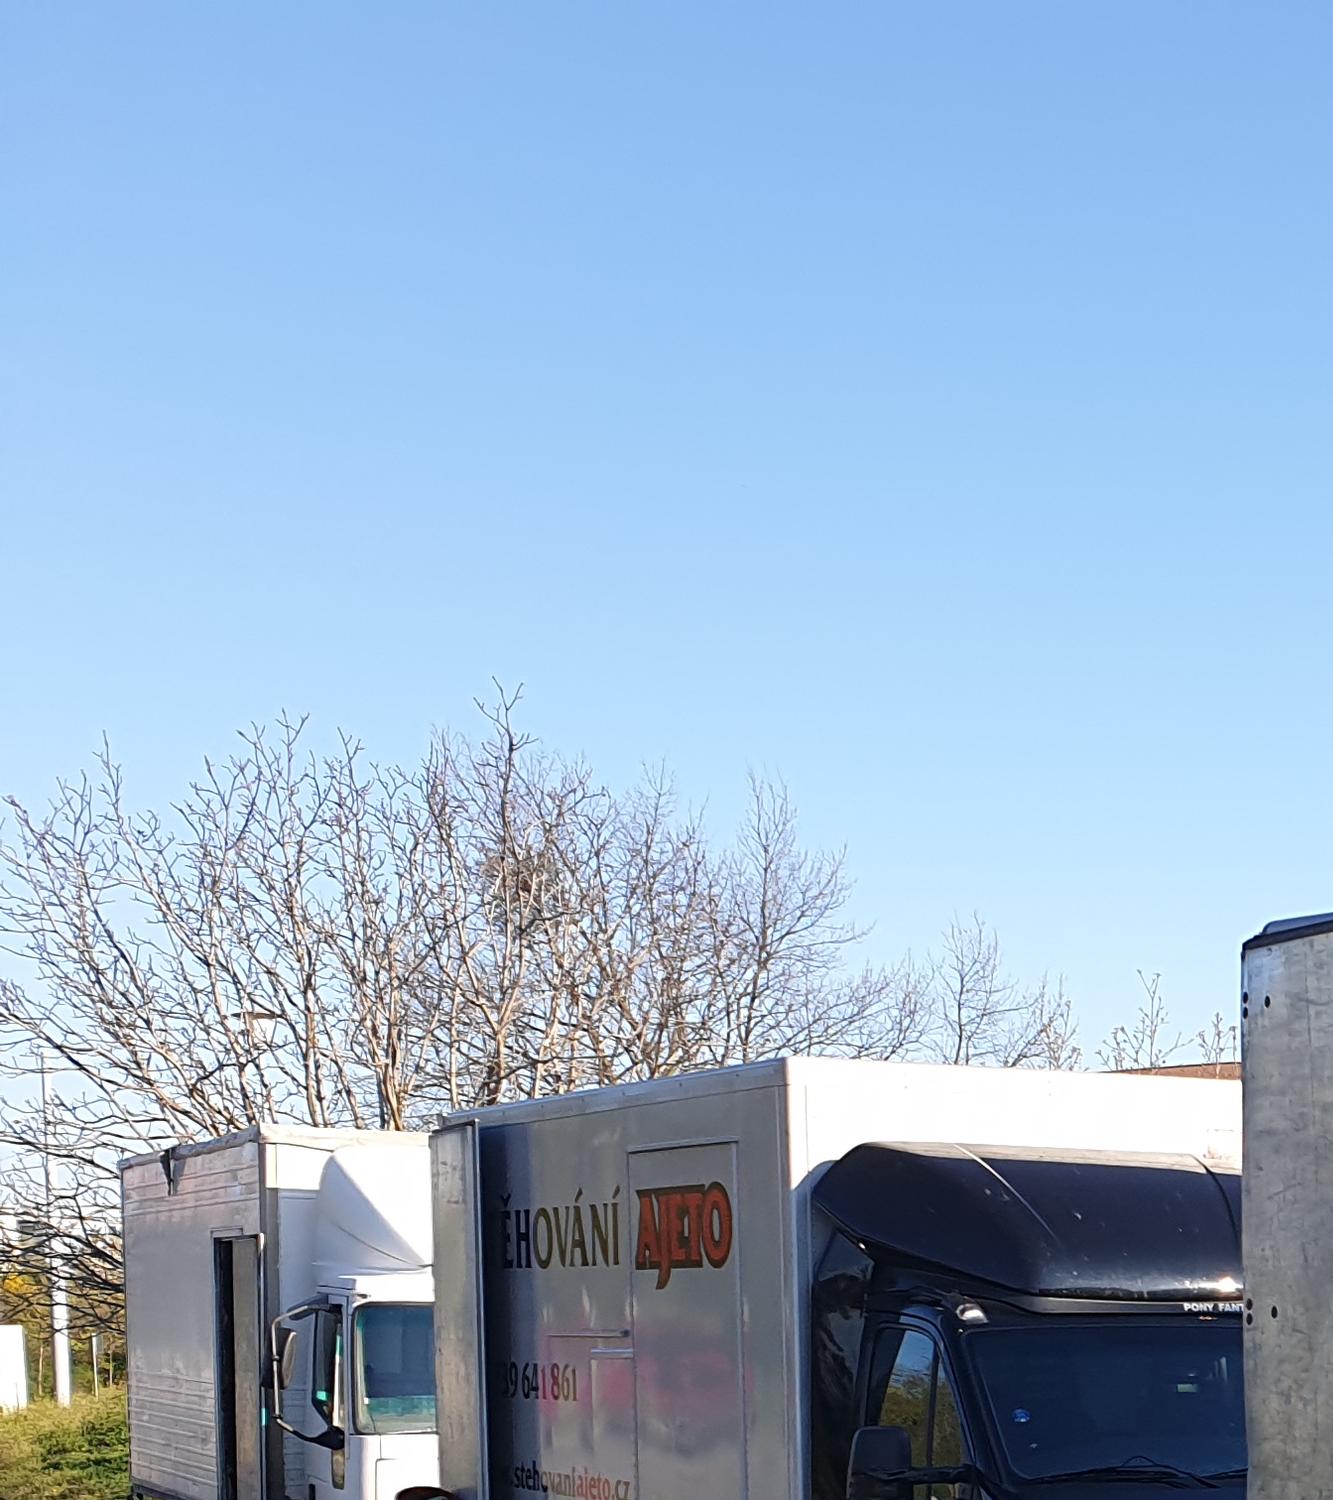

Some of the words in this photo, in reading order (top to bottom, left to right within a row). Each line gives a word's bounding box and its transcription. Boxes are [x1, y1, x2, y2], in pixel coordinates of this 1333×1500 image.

[635, 1181, 733, 1289] AJETO
[1183, 1303, 1214, 1312] PONY
[550, 1363, 578, 1402] 861
